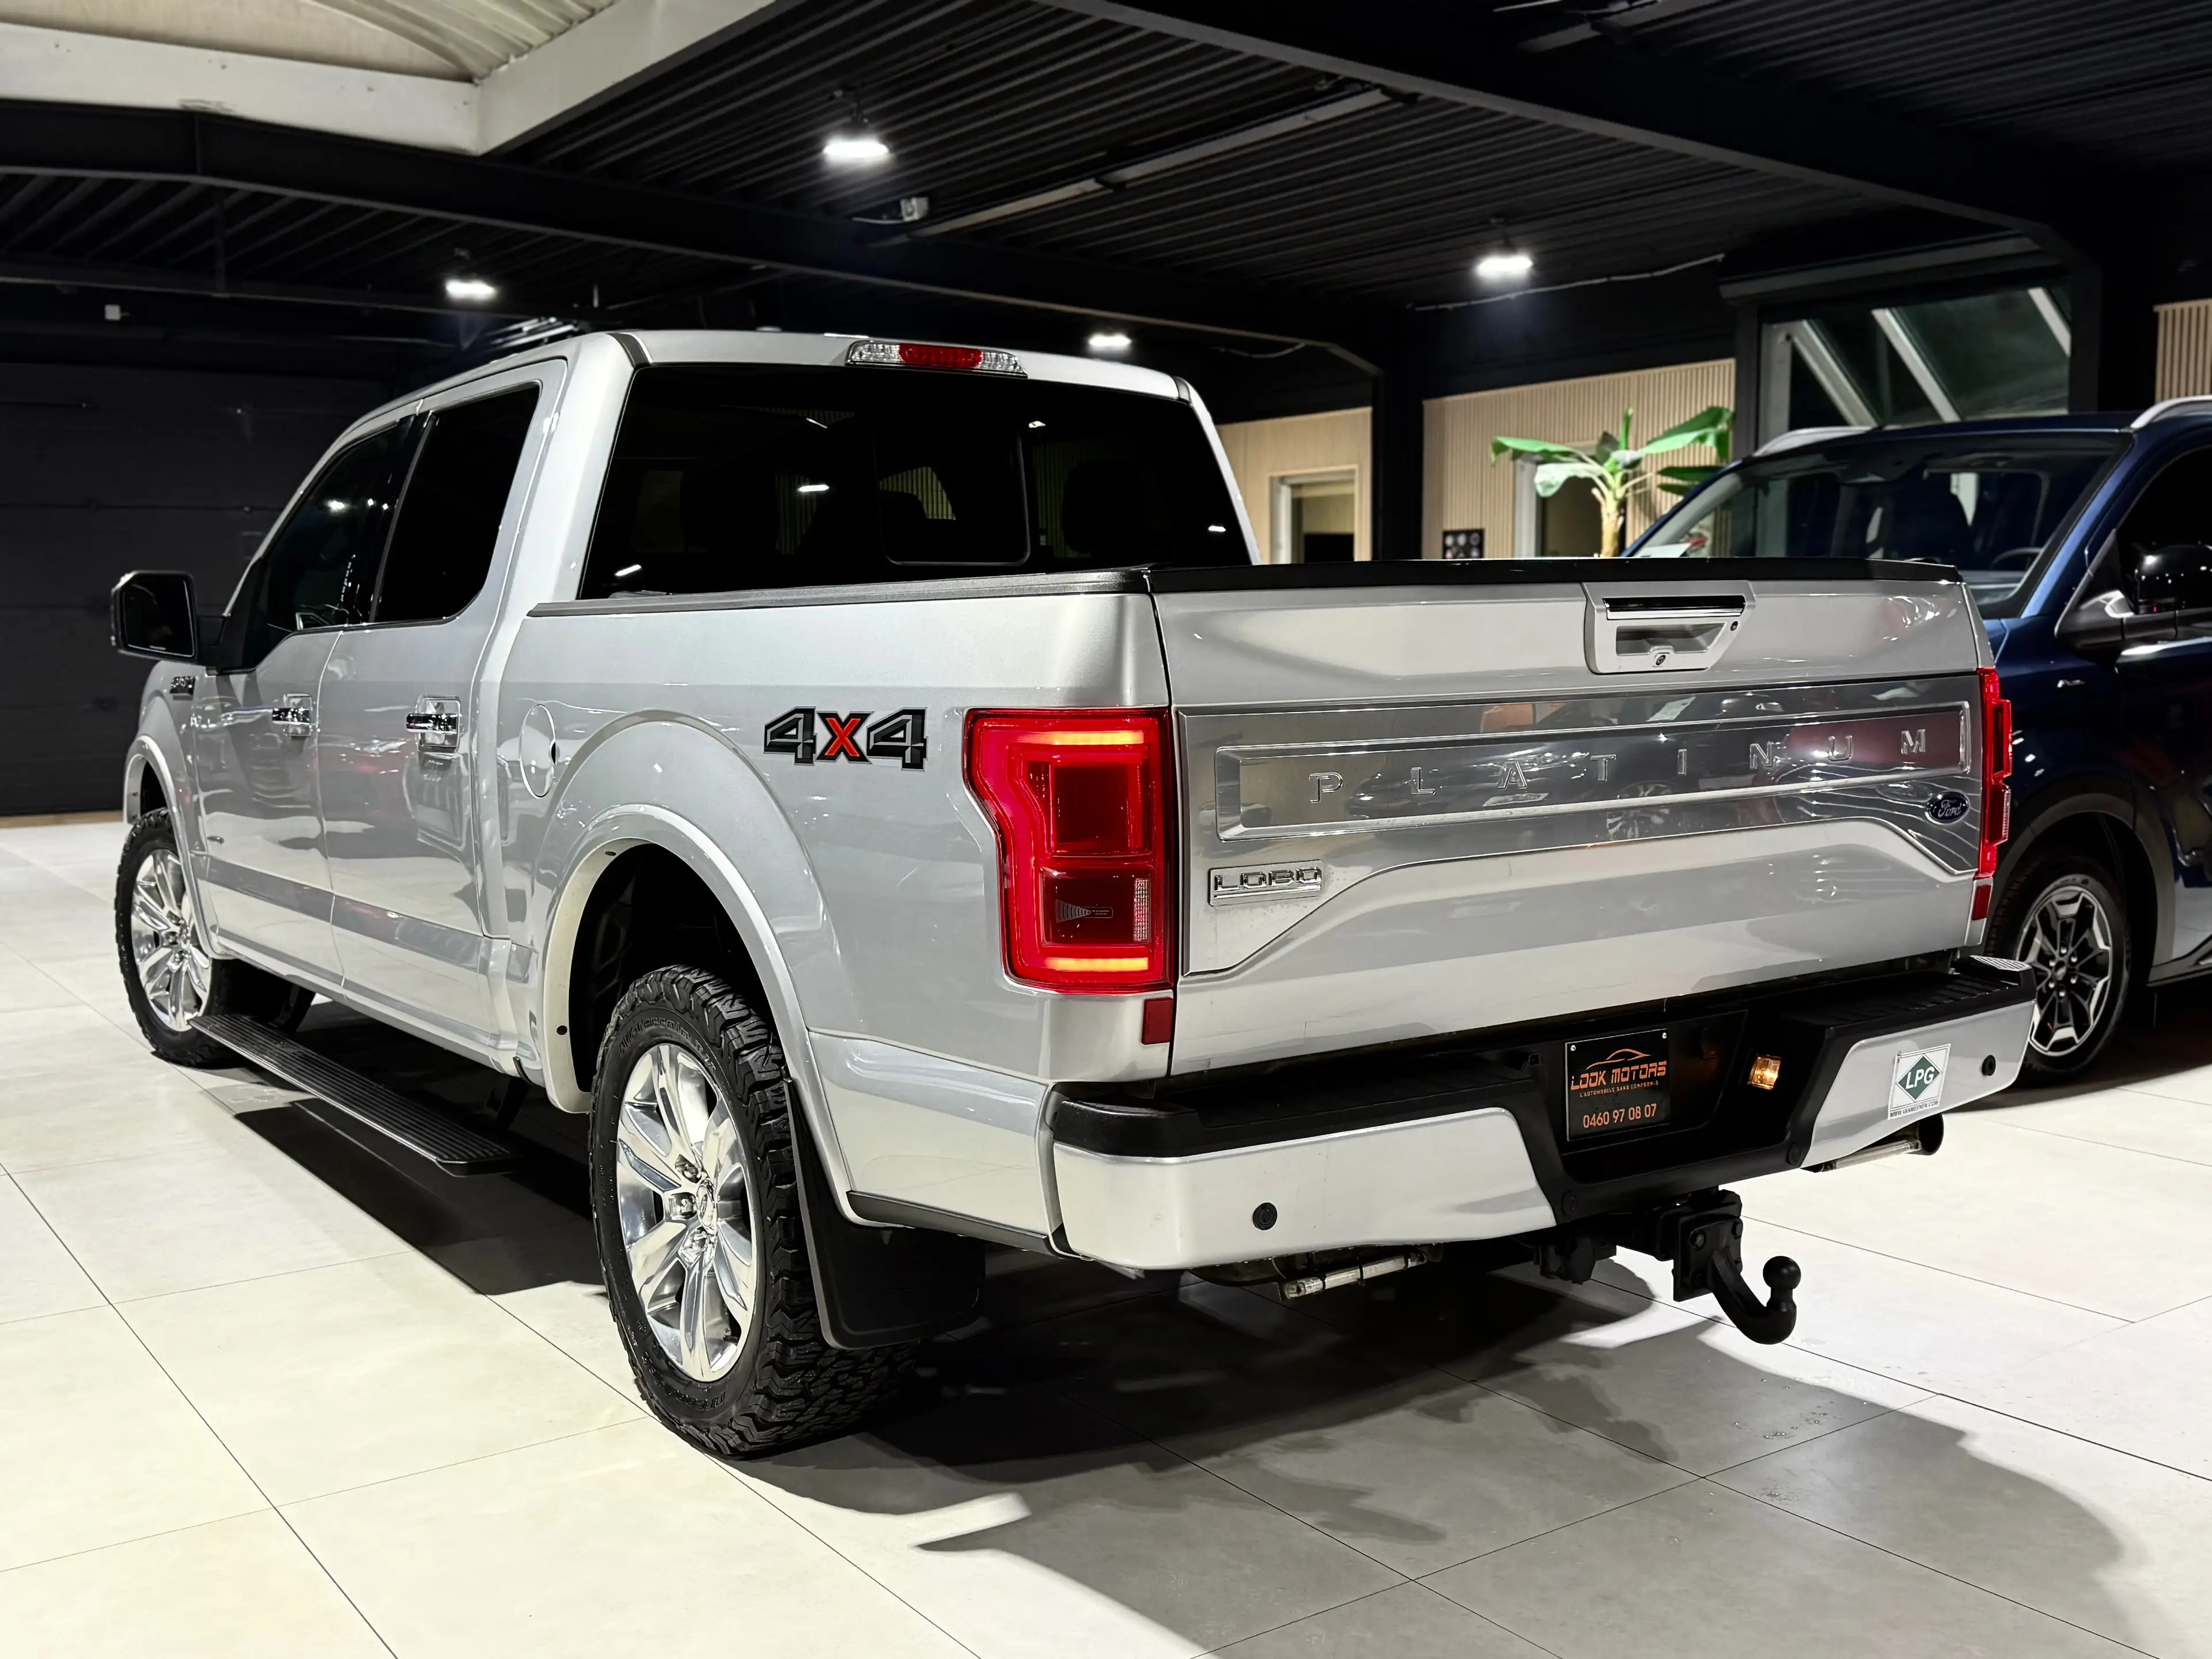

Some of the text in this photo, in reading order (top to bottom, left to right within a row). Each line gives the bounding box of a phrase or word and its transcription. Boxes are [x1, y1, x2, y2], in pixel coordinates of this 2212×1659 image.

[1308, 728, 1926, 804] PLATINUM
[1214, 866, 1323, 892] LOBO
[1570, 1060, 1667, 1090] LOOK MOTORS
[1905, 1066, 1935, 1089] LPG
[1583, 1103, 1657, 1128] 0460 97 08 07
